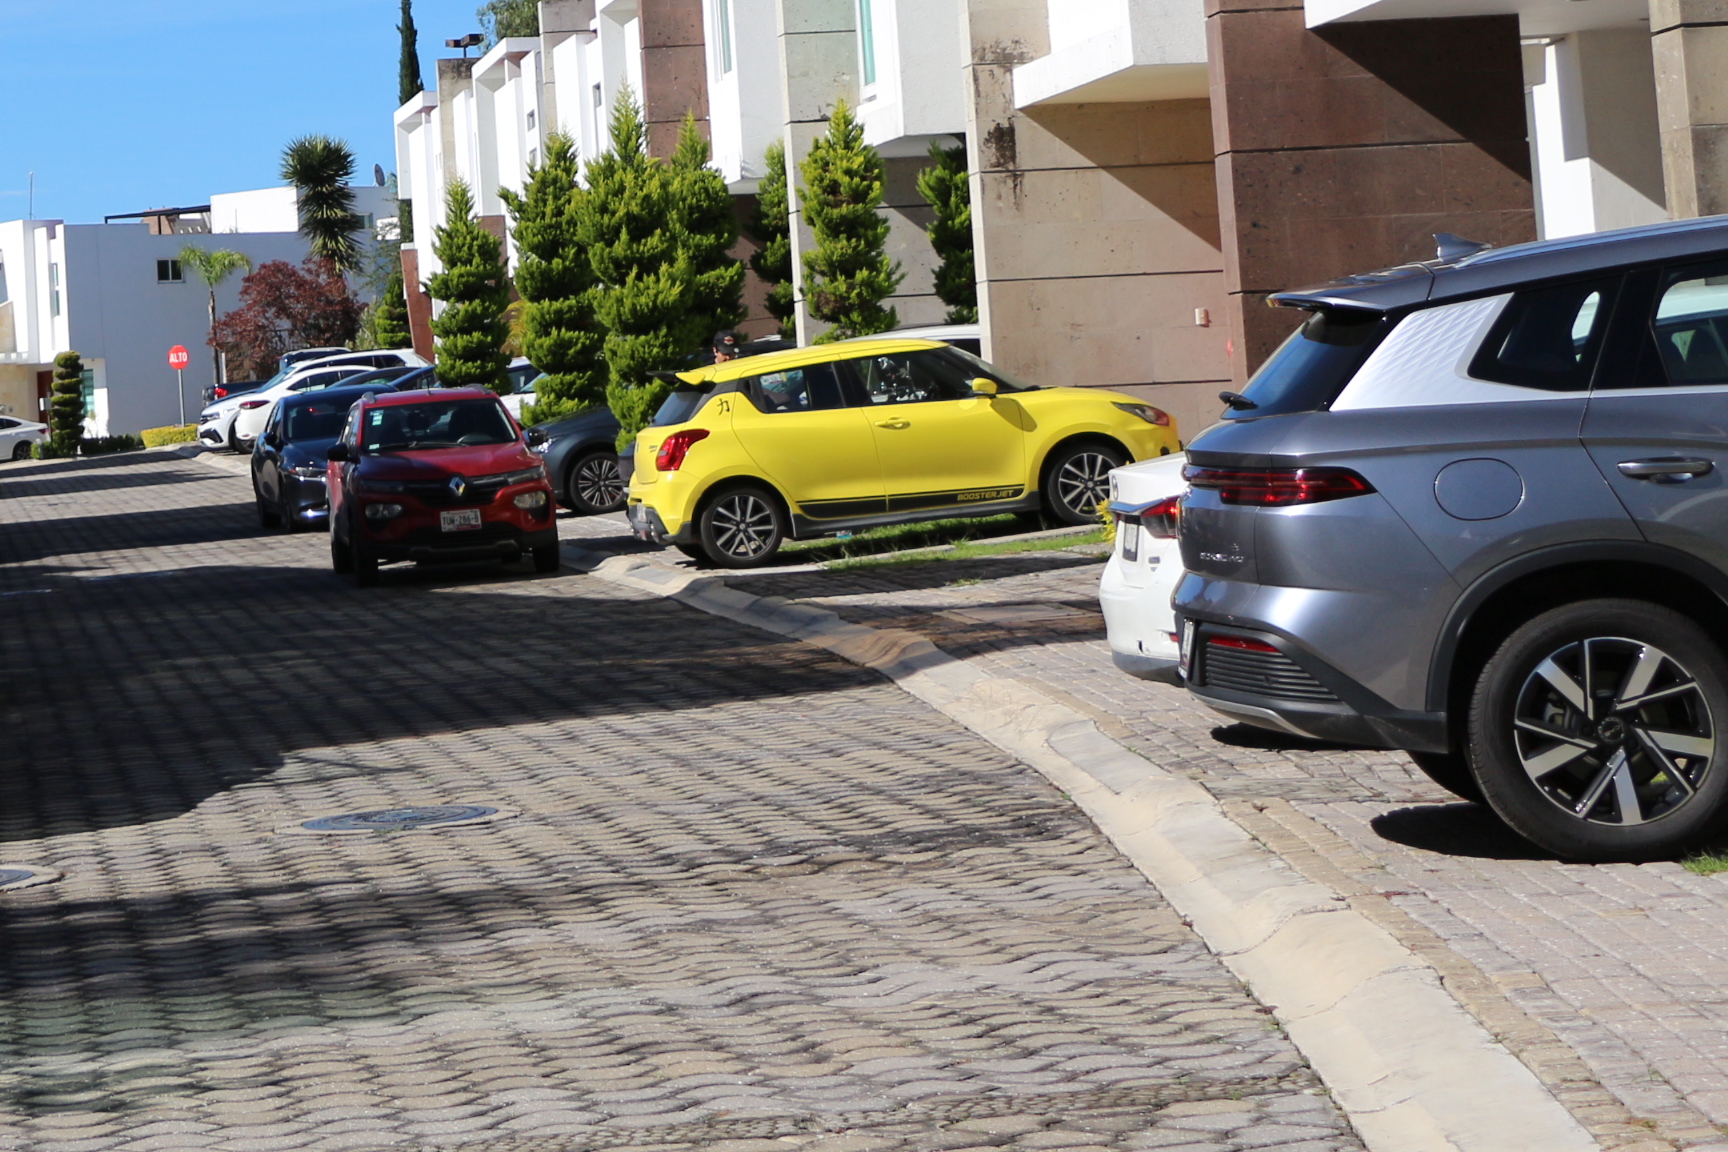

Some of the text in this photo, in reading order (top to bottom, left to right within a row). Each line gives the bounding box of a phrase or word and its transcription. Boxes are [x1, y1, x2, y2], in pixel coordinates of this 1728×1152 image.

[169, 352, 188, 363] ALTO
[716, 398, 730, 416] 力
[957, 489, 1014, 501] BOOSTERJET
